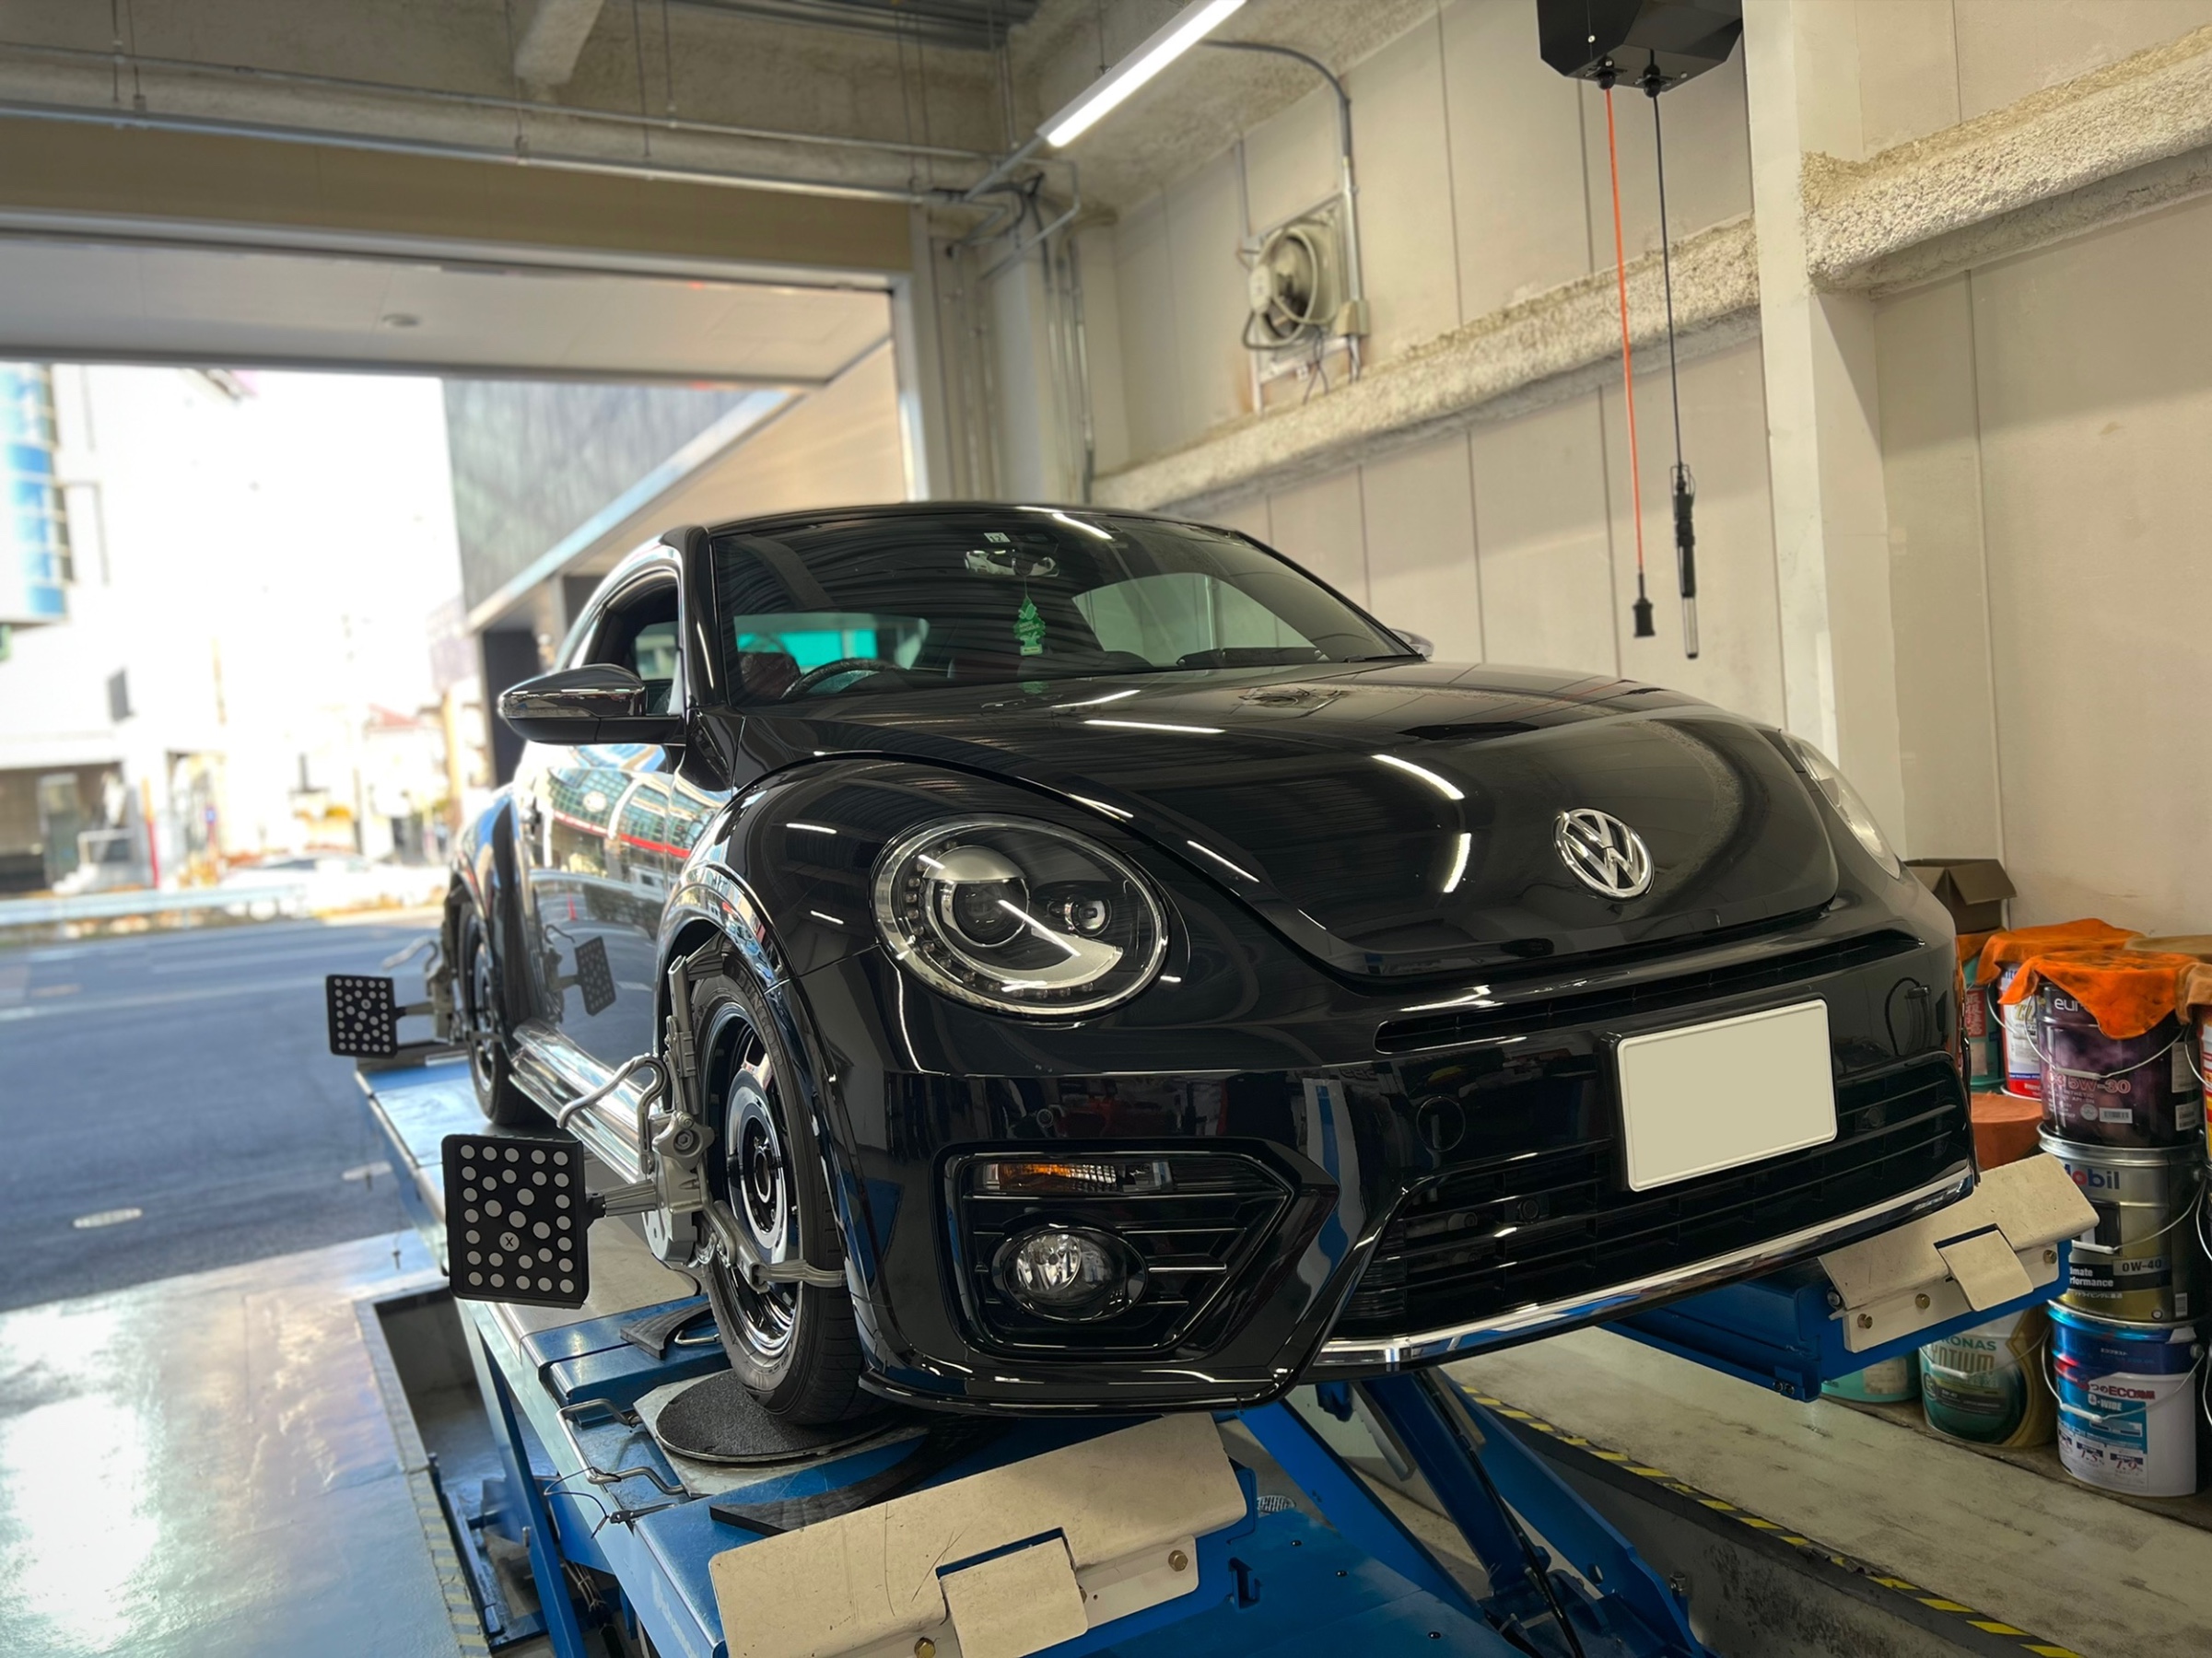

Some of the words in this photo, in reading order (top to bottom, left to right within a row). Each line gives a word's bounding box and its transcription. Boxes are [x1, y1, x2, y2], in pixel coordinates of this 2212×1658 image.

[2068, 1076, 2131, 1094] 5W-30
[2122, 1259, 2162, 1272] 0W-40
[2069, 1276, 2114, 1288] rformance
[1942, 1336, 1997, 1351] ONAS
[1930, 1343, 1995, 1376] YNTIUM
